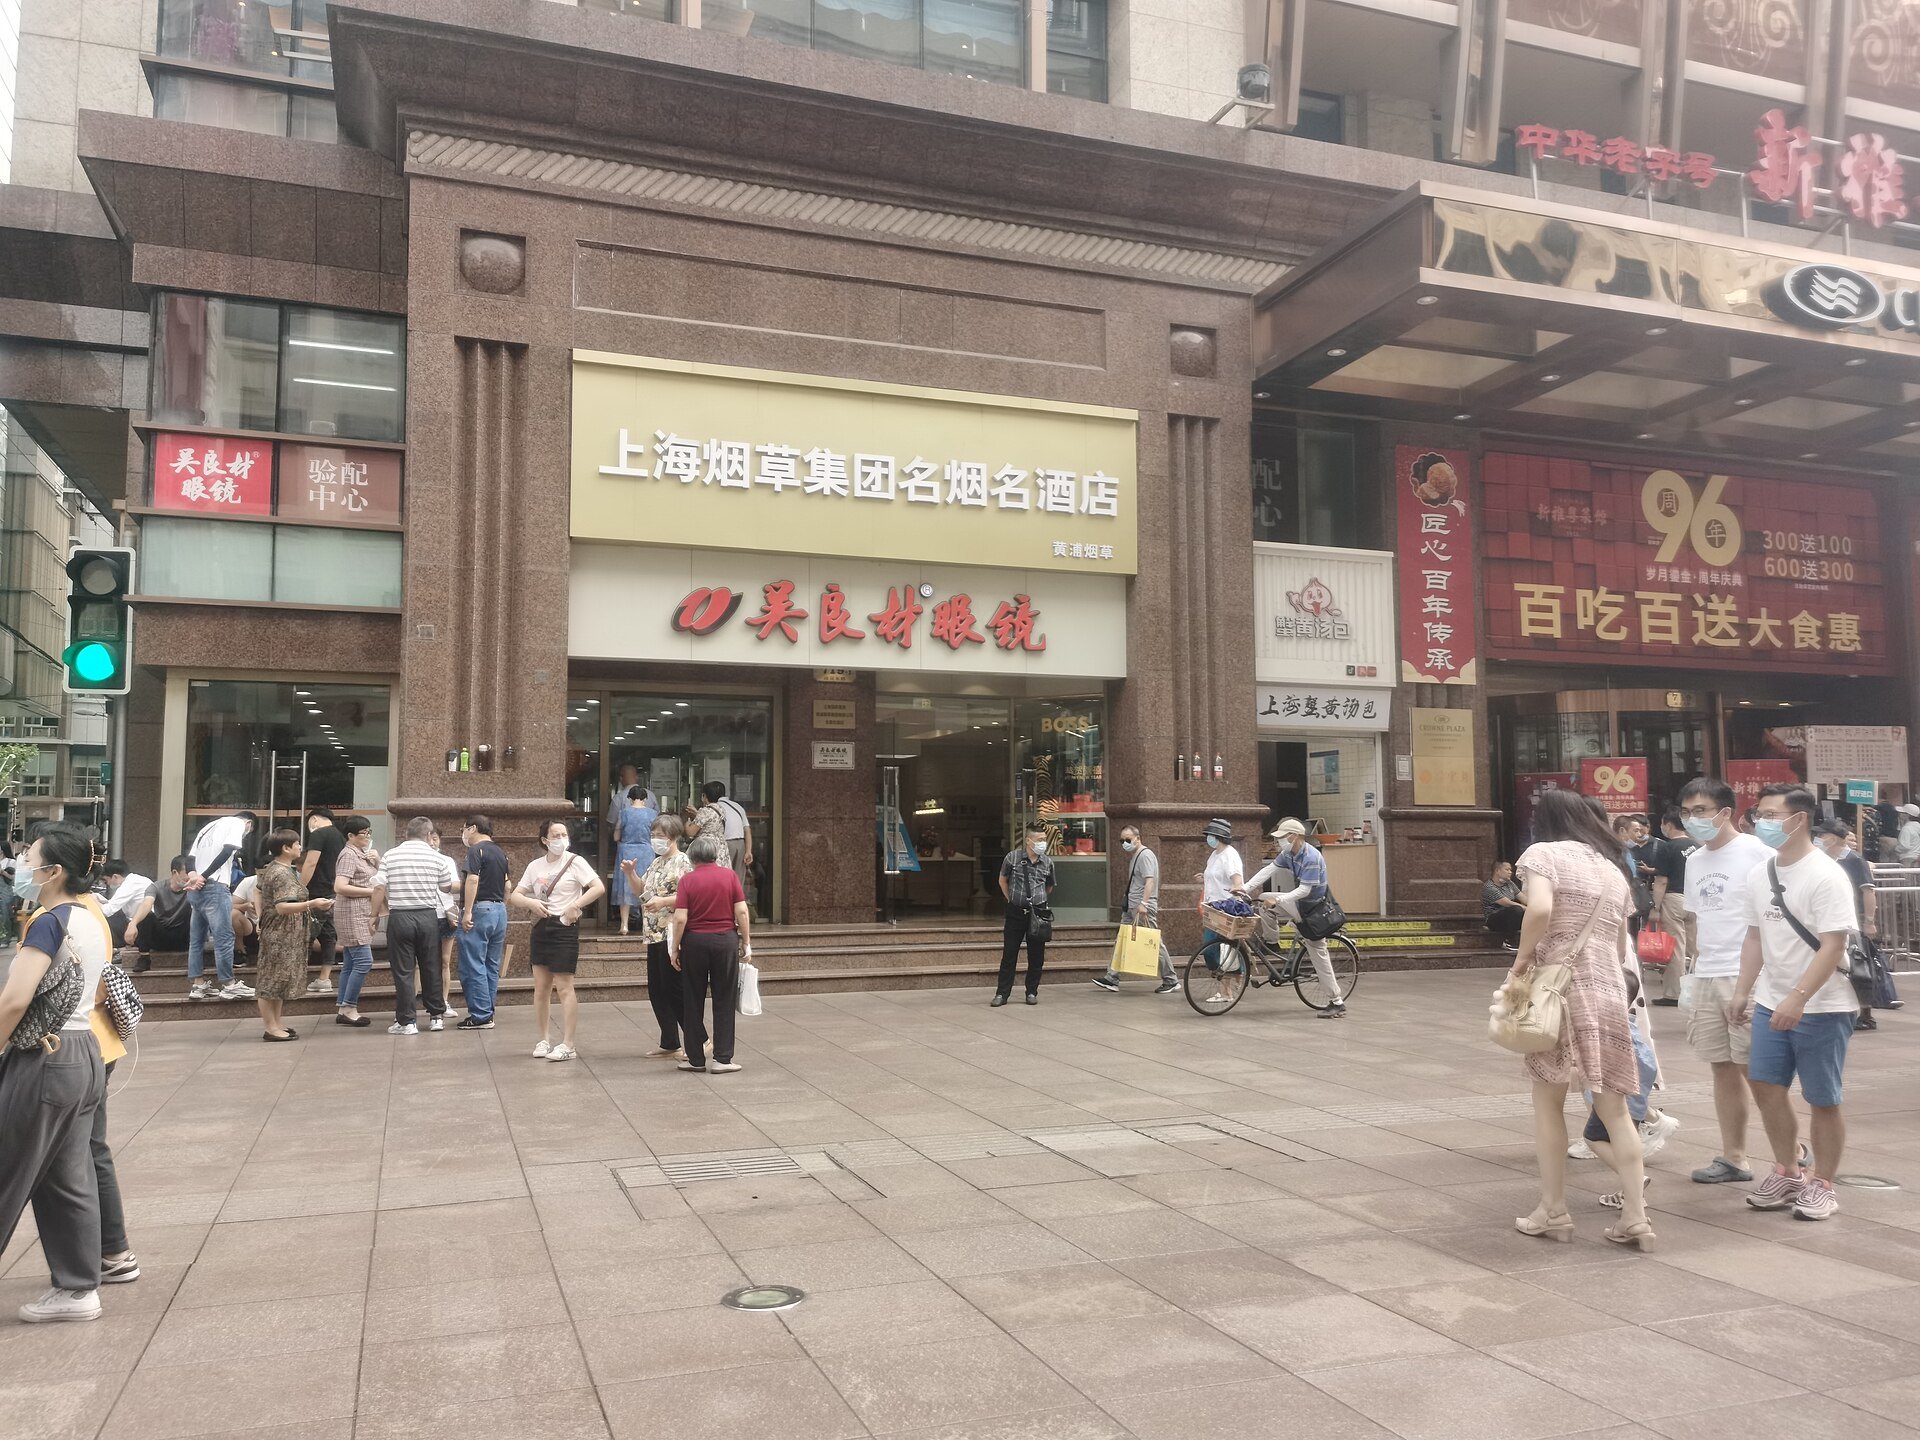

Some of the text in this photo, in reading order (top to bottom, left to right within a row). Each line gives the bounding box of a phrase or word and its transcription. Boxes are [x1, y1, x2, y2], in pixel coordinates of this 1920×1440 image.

[1516, 122, 1718, 188] 中华老字号
[1748, 108, 1920, 229] 新雅
[169, 447, 256, 481] 吴良材
[308, 459, 369, 487] 验配
[598, 428, 1120, 517] 上海烟草集团名烟名酒店
[181, 476, 242, 505] 眼镜
[308, 485, 369, 512] 中心
[1641, 469, 1742, 567] 96
[1051, 539, 1114, 561] 黄浦烟草
[1762, 530, 1852, 556] 300送100
[1764, 556, 1854, 582] 600送300
[1420, 511, 1455, 671] 匠心百年传承
[744, 579, 1047, 652] 吴良材眼镜
[1275, 615, 1350, 641] 蟹黄汤包
[1512, 581, 1863, 653] 百吃百送大食惠
[1041, 716, 1091, 733] BOSS
[1593, 765, 1635, 794] 96
